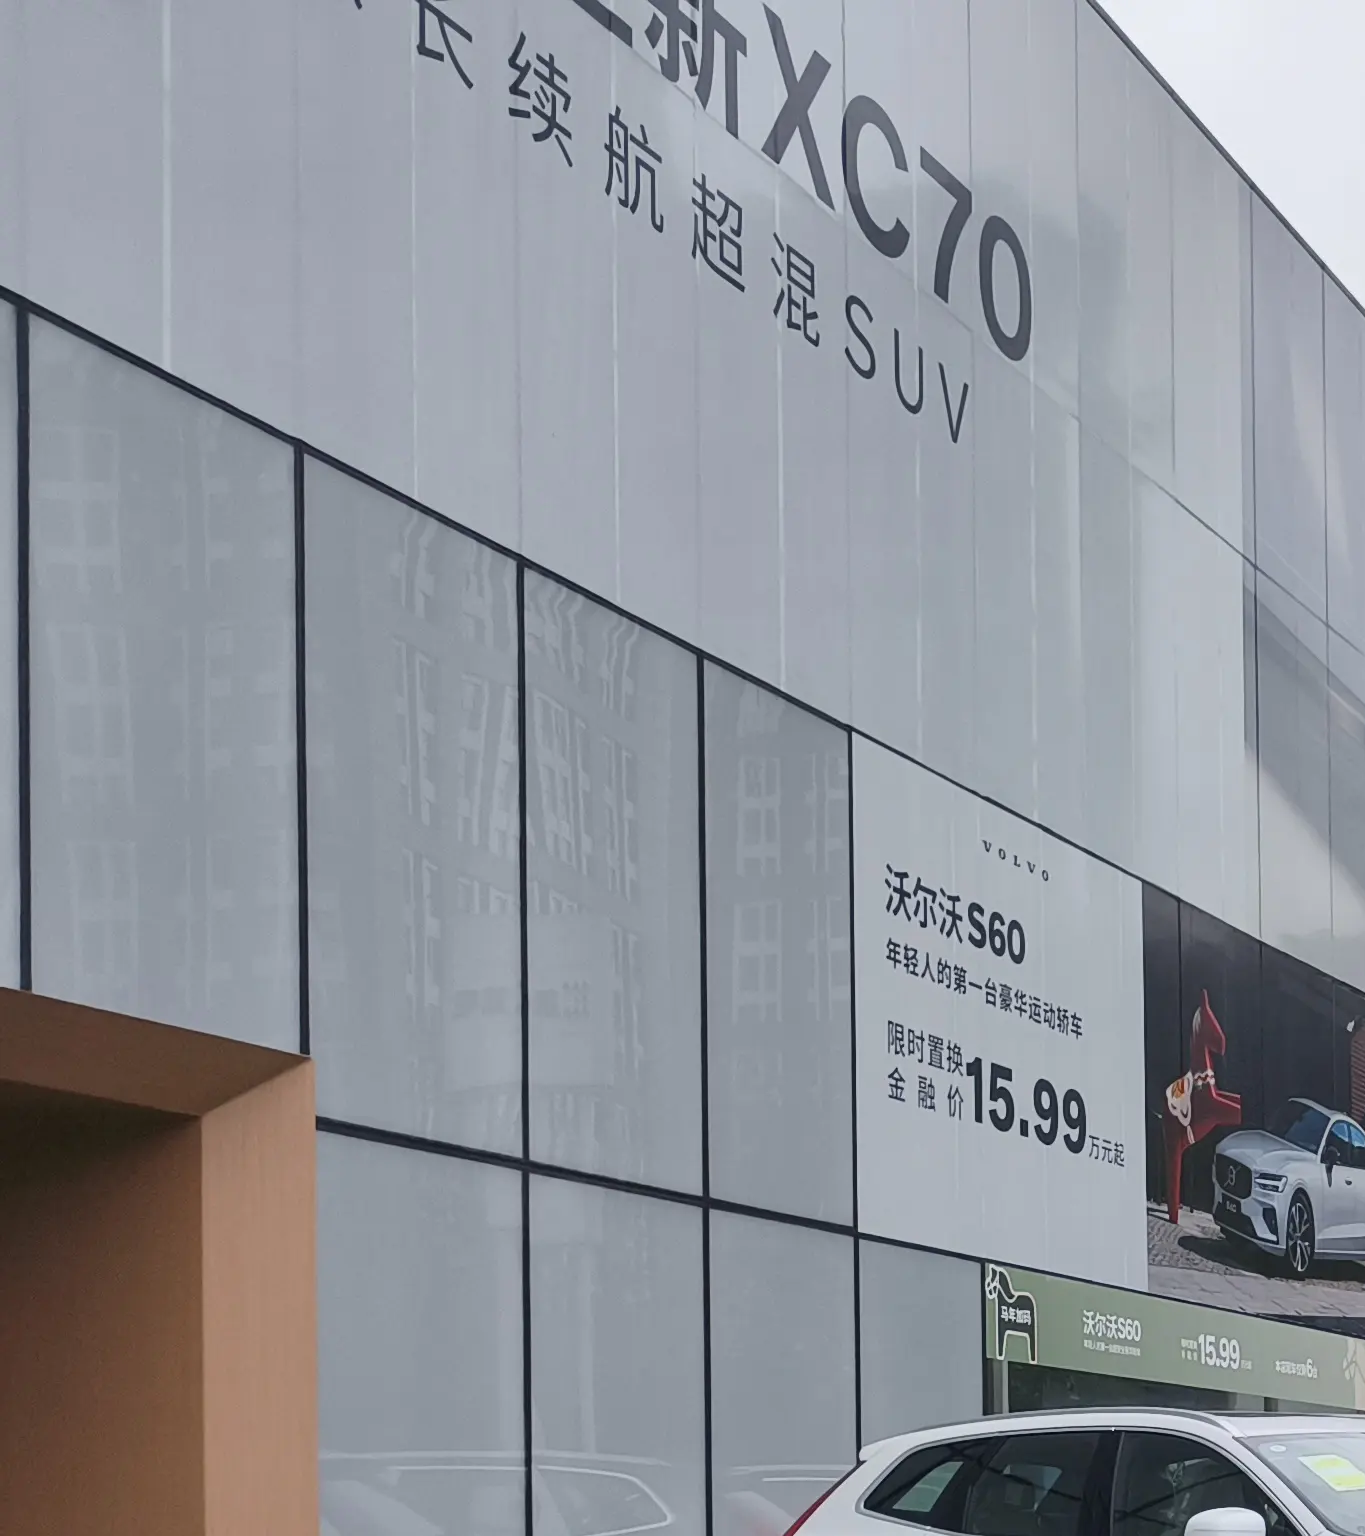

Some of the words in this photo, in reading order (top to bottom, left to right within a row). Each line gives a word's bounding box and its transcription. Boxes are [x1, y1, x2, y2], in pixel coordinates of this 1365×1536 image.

[354, 0, 969, 444] 长续航超混SUV
[572, 0, 1032, 362] 新XC70
[982, 839, 1049, 882] VOLVO
[885, 863, 1026, 965] 沃尔沃S60
[886, 938, 1083, 1040] 年轻人的第一台豪华运动轿车
[887, 1020, 964, 1077] 限时置换
[966, 1056, 1087, 1154] 15.99
[1088, 1134, 1125, 1167] 万元起
[1082, 1309, 1142, 1342] 沃尔沃S60
[1198, 1333, 1241, 1370] 15.99
